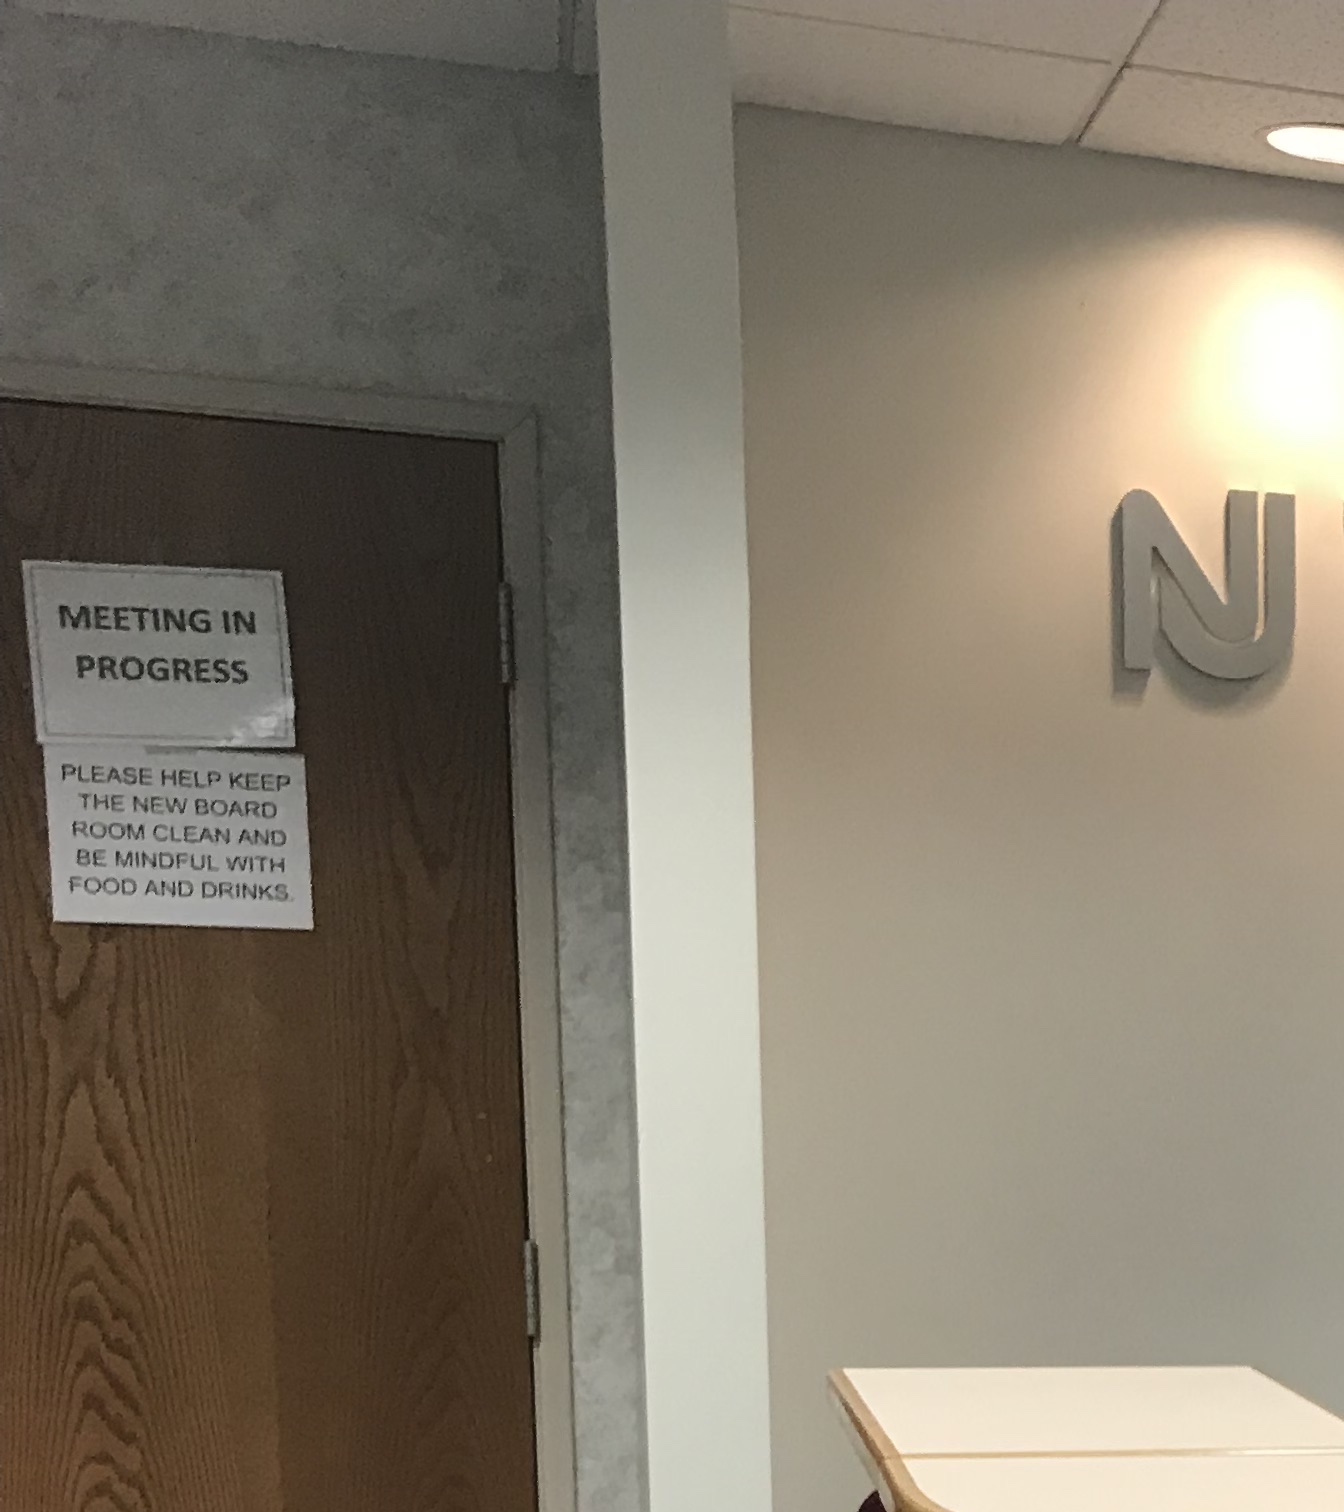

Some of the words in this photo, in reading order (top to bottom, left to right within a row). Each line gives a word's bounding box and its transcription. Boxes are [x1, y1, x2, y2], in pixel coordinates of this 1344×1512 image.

[58, 604, 212, 634] MEETING
[221, 609, 257, 636] IN
[76, 654, 250, 684] PROGRESS
[61, 763, 153, 788] PLEASE
[160, 768, 221, 790] HELP
[228, 771, 291, 792] KEEP
[77, 792, 125, 813] THE
[132, 795, 188, 815] NEW
[194, 798, 278, 820] BOARD
[72, 820, 145, 842] ROOM
[152, 823, 230, 846] CLEAN
[238, 827, 287, 848] AND
[76, 848, 107, 868] BE
[114, 849, 219, 873] MINDFUL
[226, 854, 285, 875] WITH
[68, 875, 137, 897] FOOD
[144, 877, 193, 898] AND
